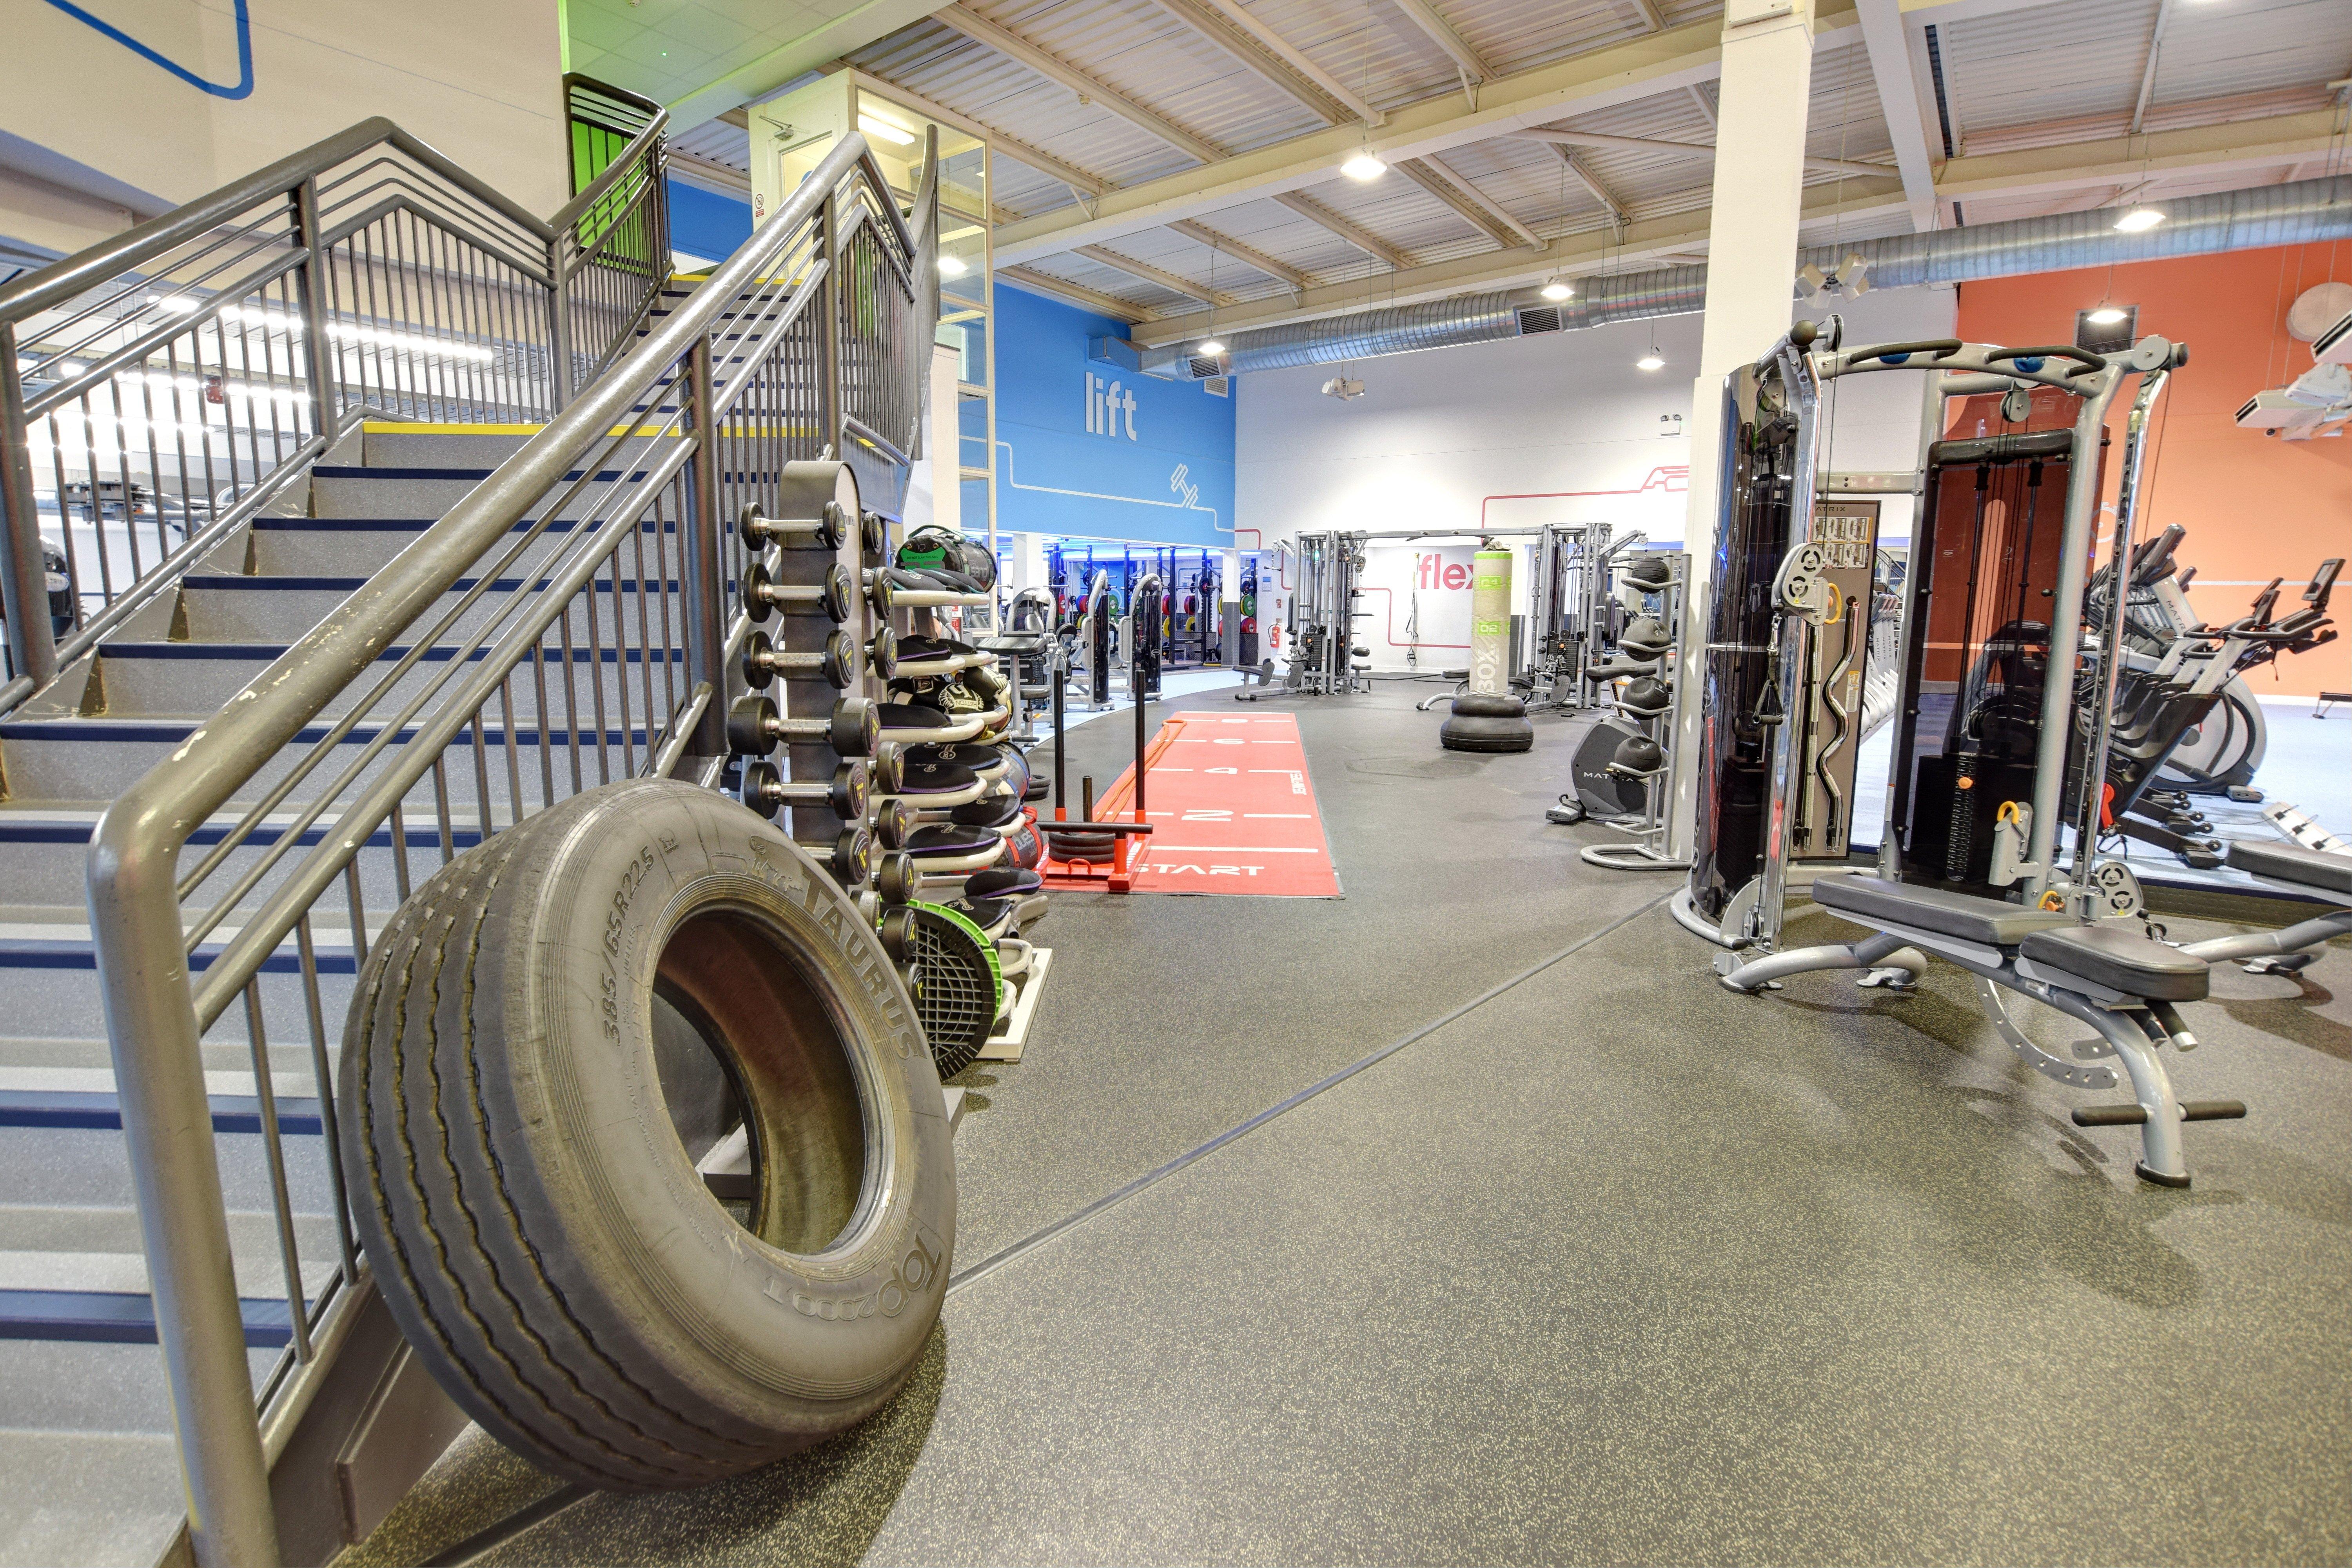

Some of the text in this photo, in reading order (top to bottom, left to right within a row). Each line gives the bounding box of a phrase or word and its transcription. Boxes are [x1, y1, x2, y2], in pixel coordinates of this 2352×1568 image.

[1086, 372, 1137, 441] lift
[1480, 624, 1498, 633] 02
[2166, 600, 2186, 630] MATR
[1181, 809, 1234, 821] 2
[802, 860, 927, 1059] TAURUS
[626, 1077, 661, 1168] REGROOVABLE
[664, 1174, 684, 1211] STEEL
[877, 1232, 942, 1318] Top
